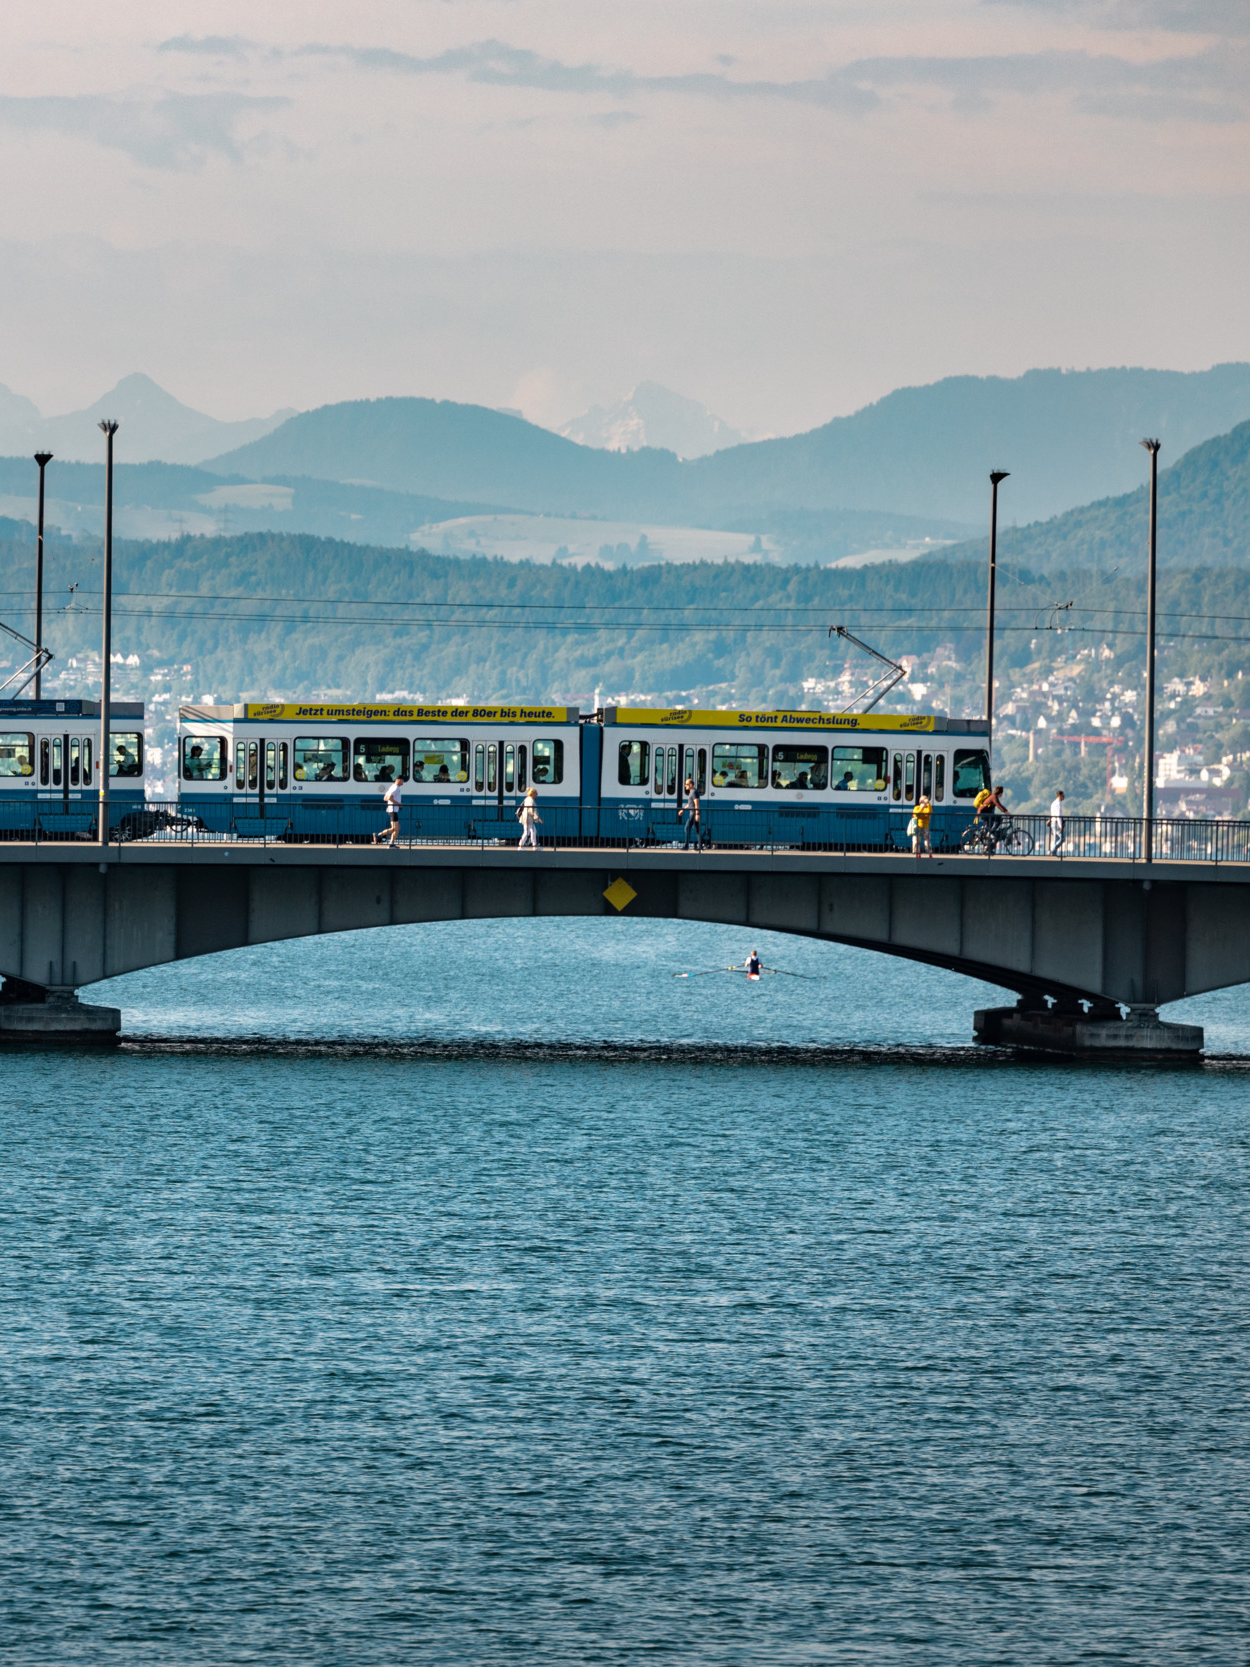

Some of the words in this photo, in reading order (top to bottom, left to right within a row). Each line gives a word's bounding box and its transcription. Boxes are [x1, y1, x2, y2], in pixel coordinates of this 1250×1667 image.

[295, 706, 324, 717] Jetzt
[327, 708, 390, 719] umsteigen:
[393, 708, 414, 717] das
[417, 708, 448, 717] Beste
[451, 708, 470, 718] der
[472, 708, 498, 718] 80er
[500, 708, 517, 718] bis
[520, 709, 556, 719] heute.
[738, 714, 752, 723] So
[755, 714, 778, 723] tönt
[781, 715, 860, 727] Abwechslung.
[359, 744, 366, 753] 5
[778, 751, 784, 760] 5
